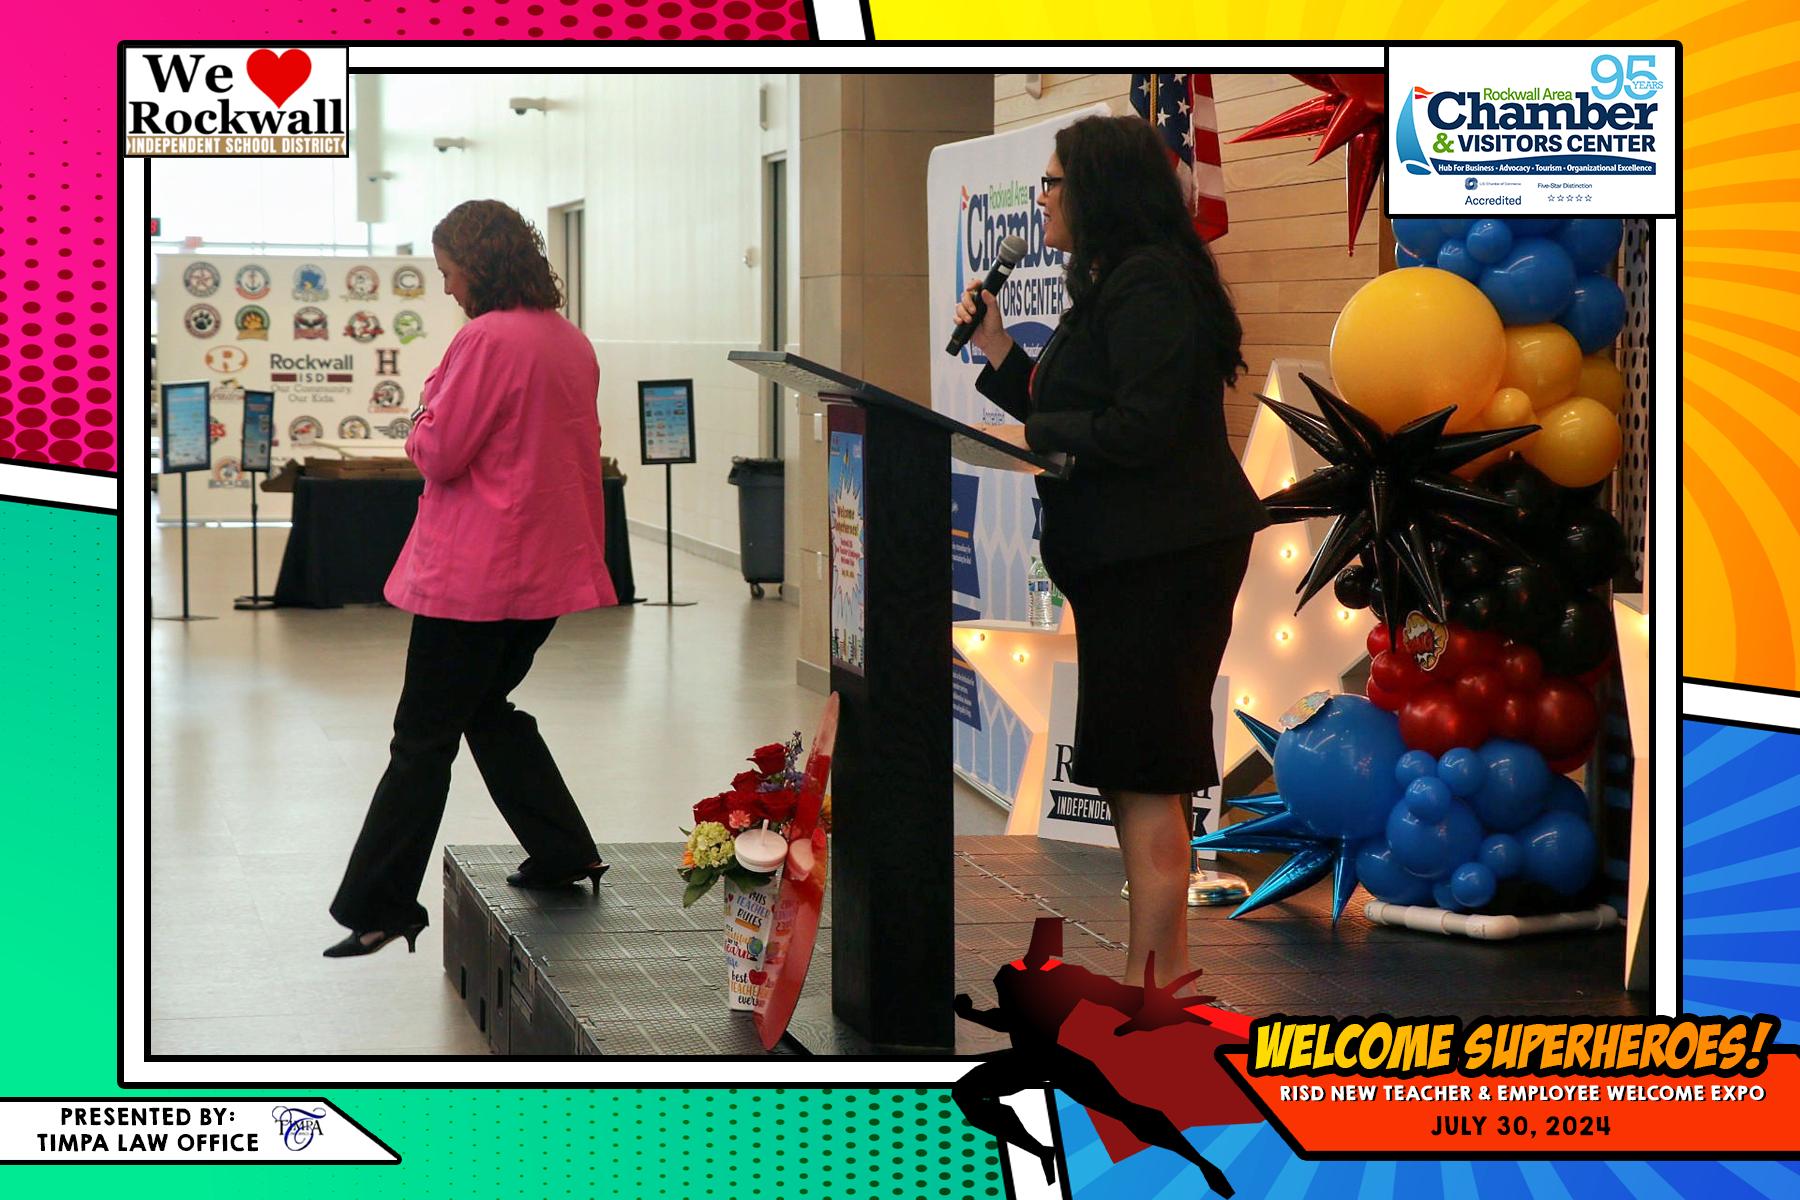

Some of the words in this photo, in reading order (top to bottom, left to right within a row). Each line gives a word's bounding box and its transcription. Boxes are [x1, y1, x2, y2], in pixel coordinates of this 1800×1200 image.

[270, 354, 353, 370] Rockwall
[376, 349, 399, 376] H
[1056, 795, 1112, 821] INDEPENDEN
[732, 969, 748, 984] best
